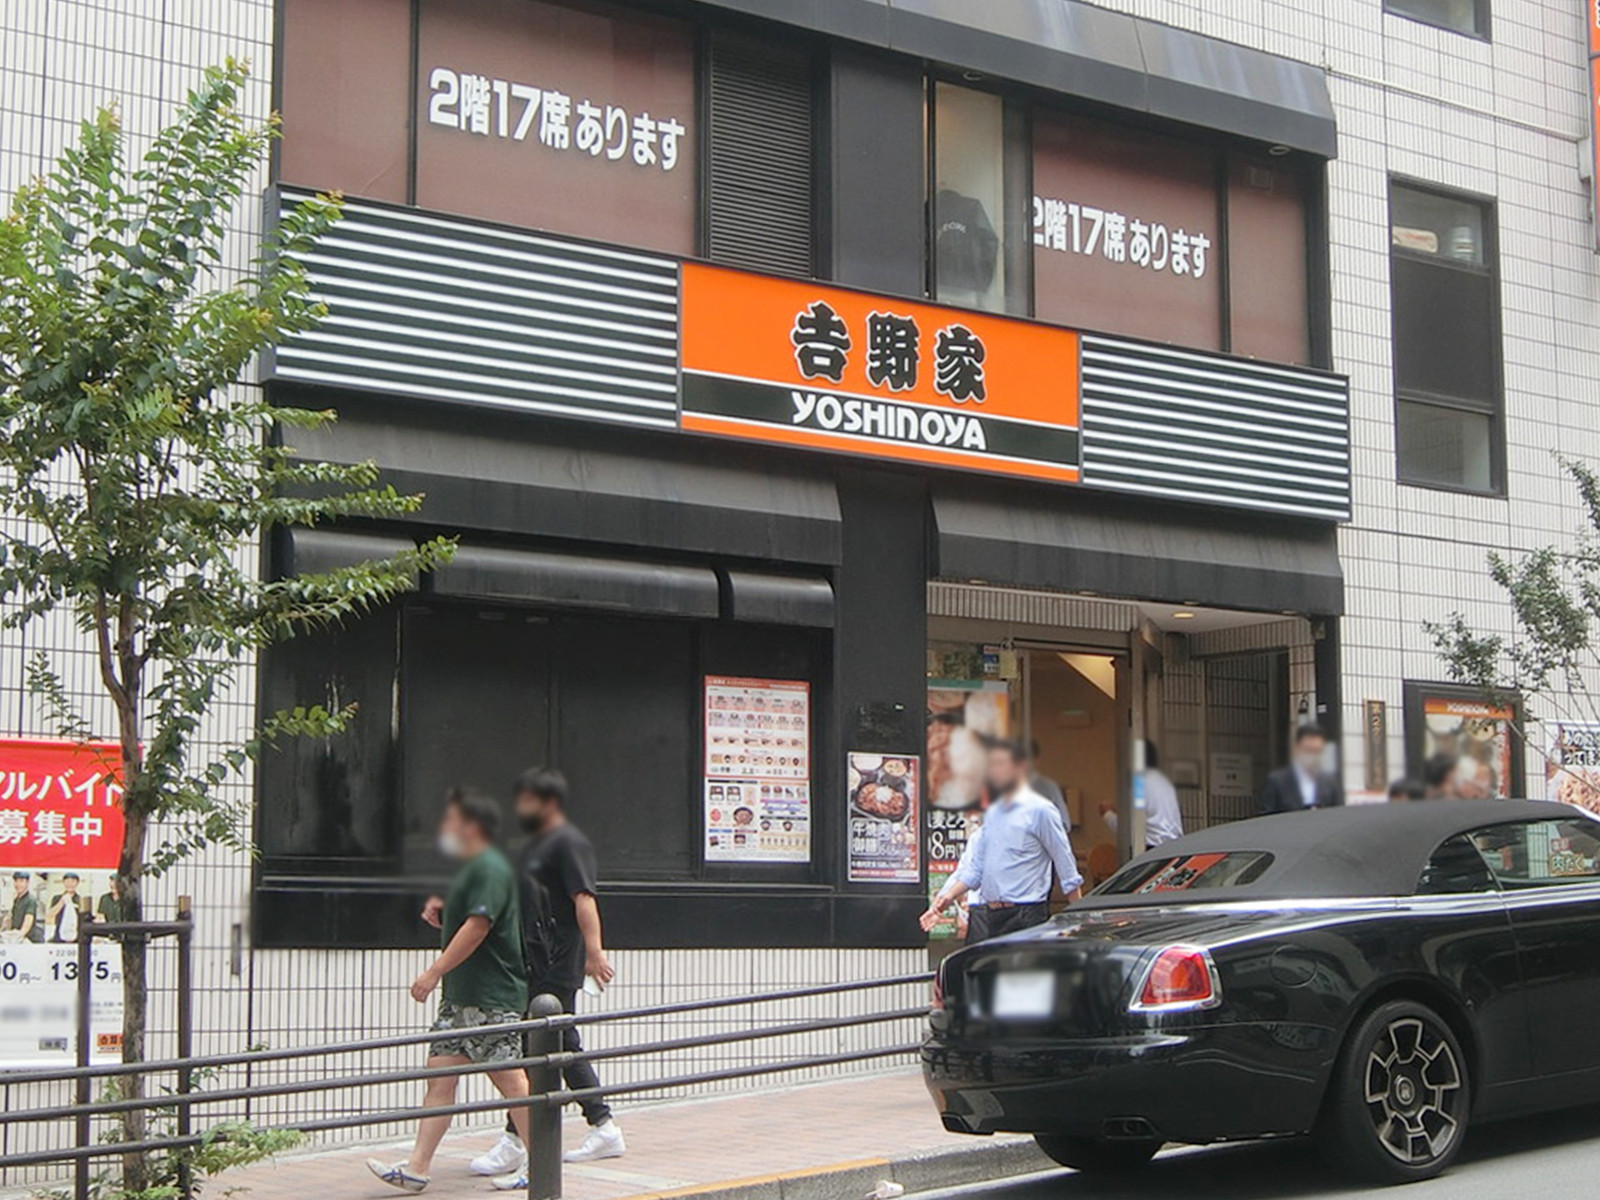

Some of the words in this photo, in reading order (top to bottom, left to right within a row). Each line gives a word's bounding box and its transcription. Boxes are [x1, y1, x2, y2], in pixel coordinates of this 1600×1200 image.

[790, 300, 986, 404] 吉野家
[791, 391, 987, 451] YOSHINOYA
[0, 768, 125, 806] ルバイト
[0, 809, 103, 846] 募集中
